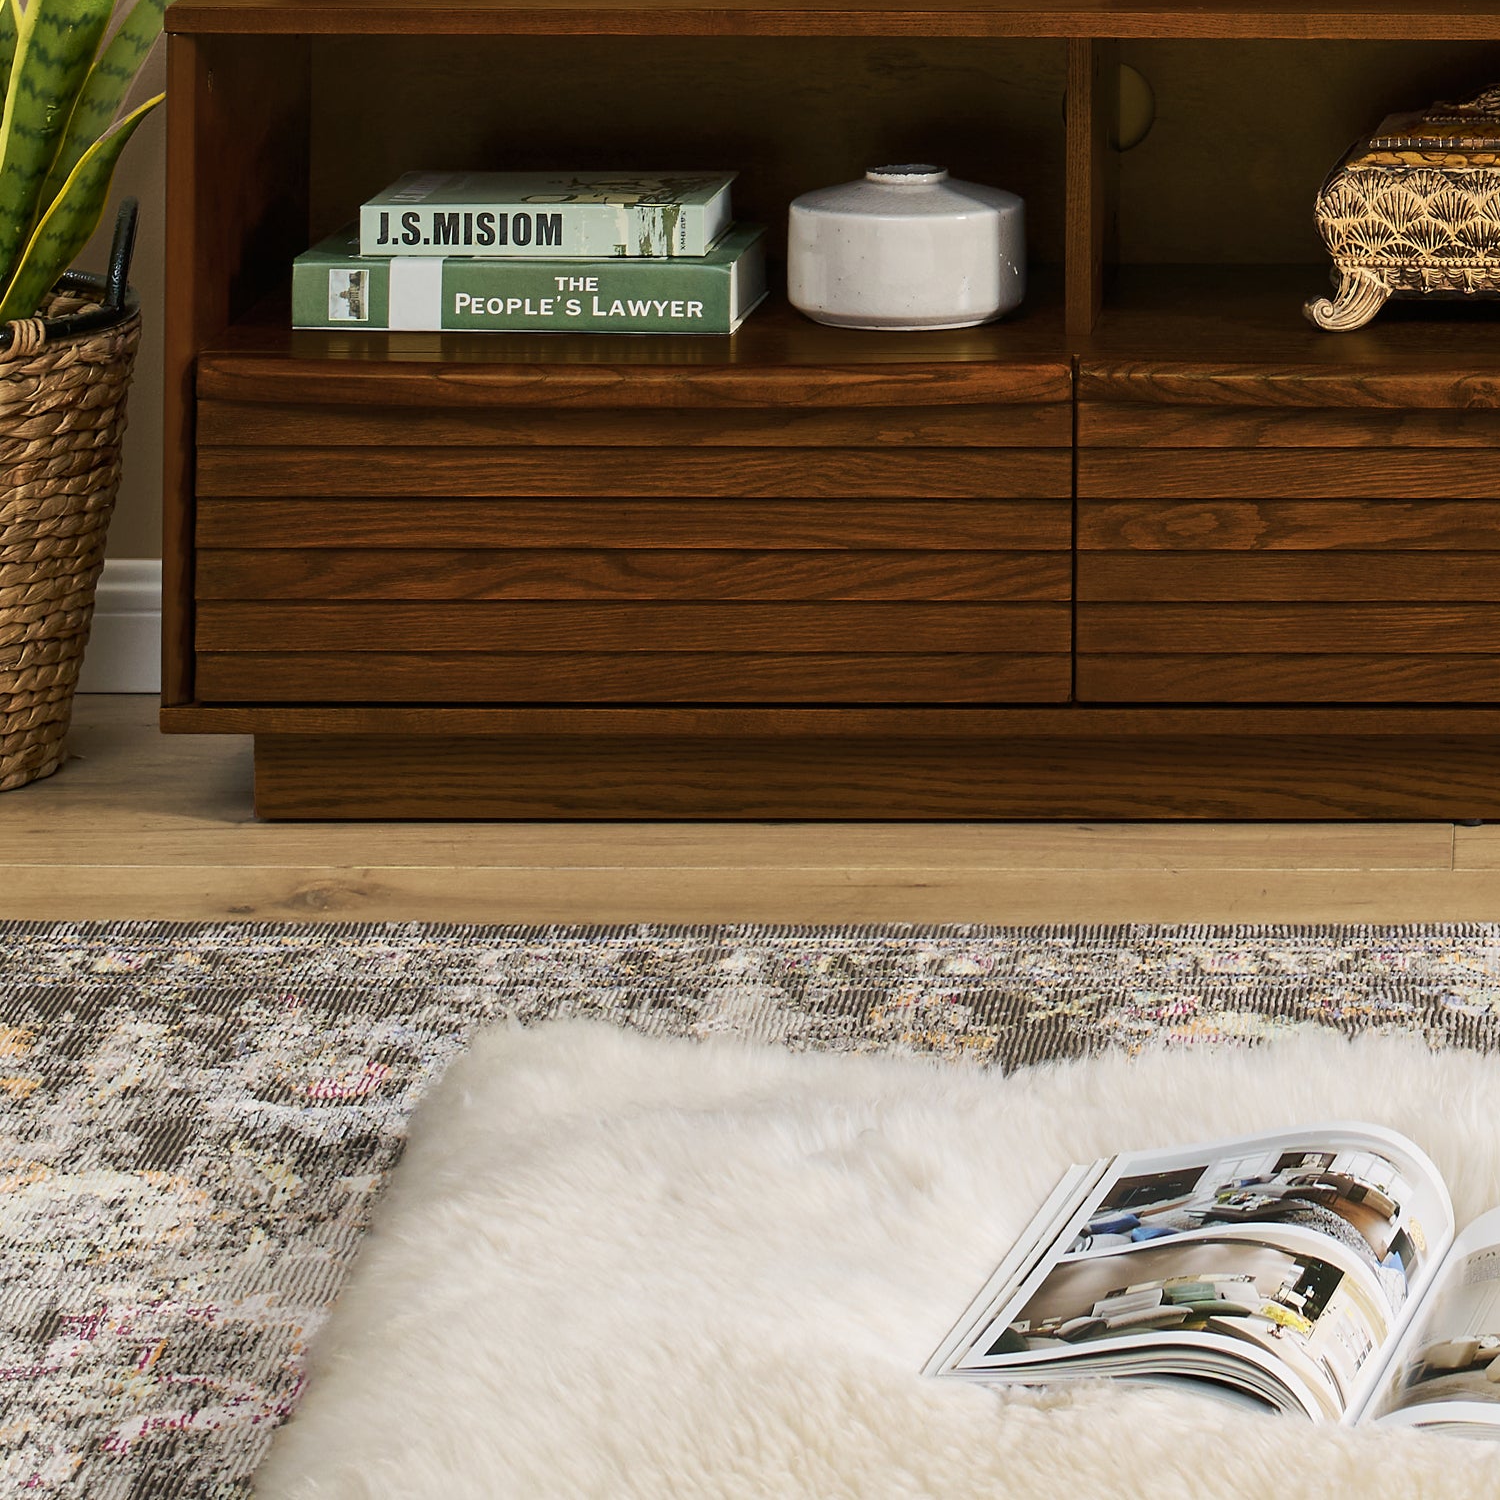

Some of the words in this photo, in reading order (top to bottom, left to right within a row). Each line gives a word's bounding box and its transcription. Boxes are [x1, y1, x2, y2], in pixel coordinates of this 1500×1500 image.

[376, 211, 563, 246] J.S.MISIOM
[554, 276, 599, 293] THE
[592, 296, 704, 319] LAWYER
